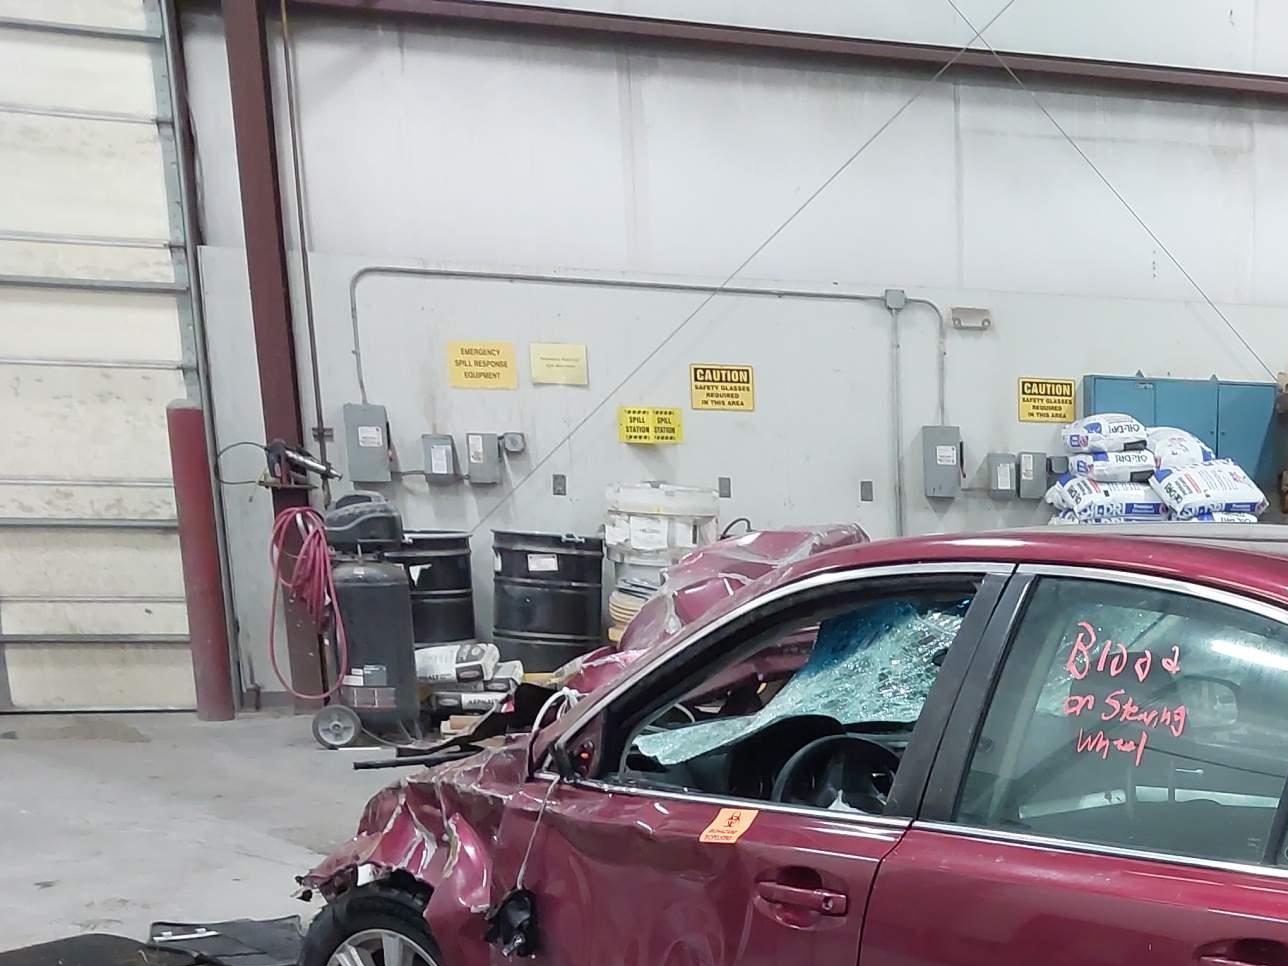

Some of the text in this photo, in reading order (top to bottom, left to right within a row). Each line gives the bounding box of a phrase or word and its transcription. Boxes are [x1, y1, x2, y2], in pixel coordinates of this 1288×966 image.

[460, 348, 500, 356] EMERGENCY
[454, 360, 508, 369] SPILL RESPONSE
[464, 372, 500, 380] EQUIPMENT
[696, 369, 748, 383] CAUTION
[1024, 383, 1071, 396] CAUTION
[629, 416, 646, 424] SPILL
